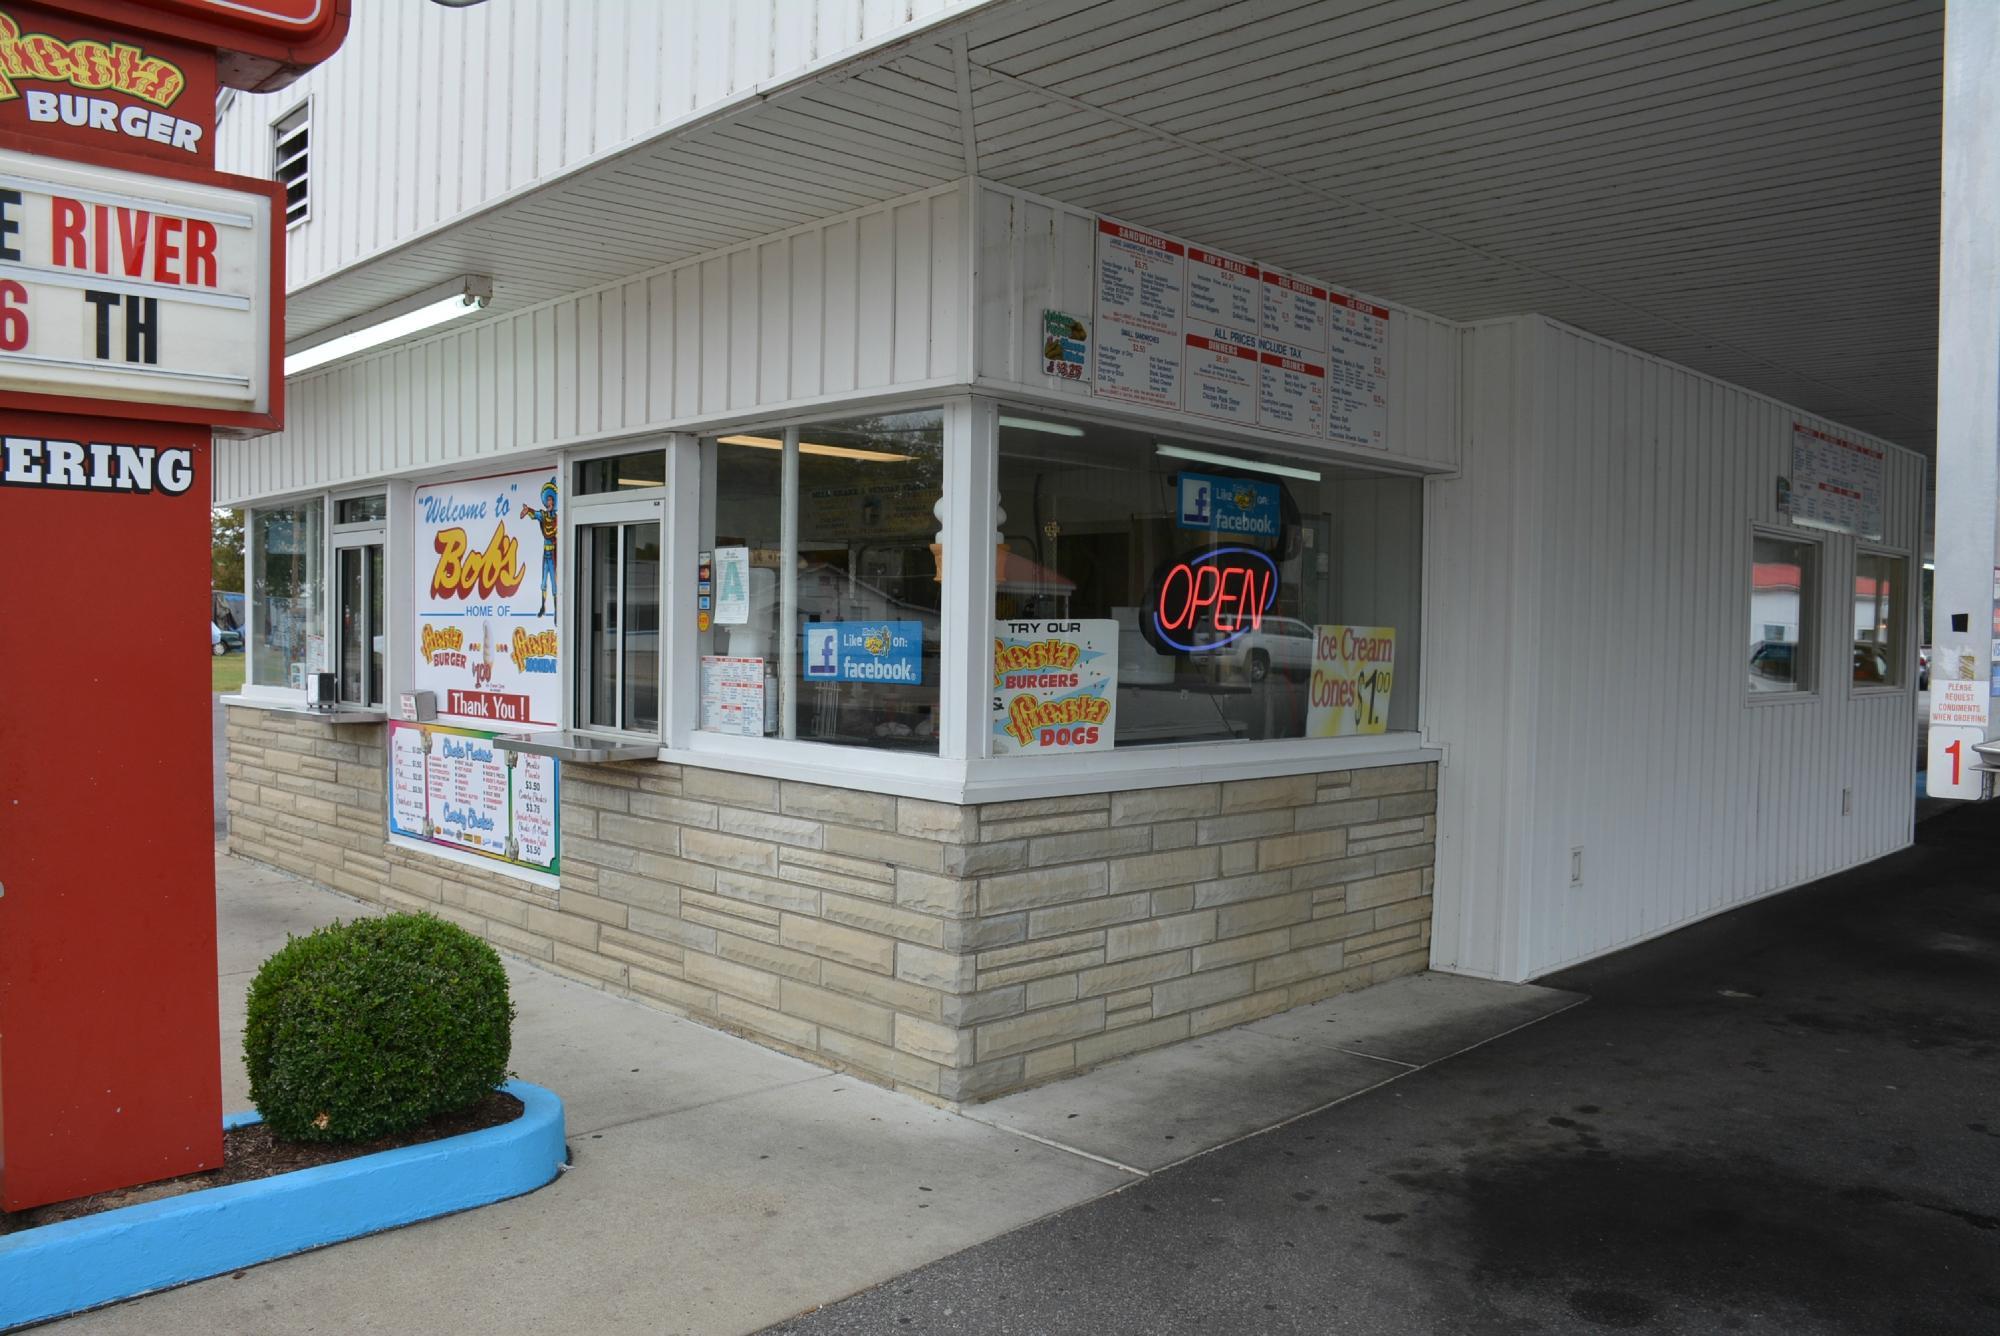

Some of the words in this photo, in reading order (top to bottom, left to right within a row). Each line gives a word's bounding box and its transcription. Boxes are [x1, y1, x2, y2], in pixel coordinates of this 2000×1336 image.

[26, 90, 203, 153] BURGER
[52, 196, 218, 288] RIVER
[1119, 226, 1167, 250] SANDWICHES
[1223, 258, 1247, 275] MEALS
[1356, 301, 1373, 316] CREAM
[85, 290, 158, 364] TH
[1214, 328, 1229, 341] ALL
[1230, 331, 1257, 348] PRICES
[1258, 339, 1288, 356] INCLUDE
[1289, 346, 1304, 360] TAX
[1282, 359, 1305, 373] DRINKS
[4, 436, 193, 493] ERING
[1216, 488, 1233, 501] Like
[431, 519, 526, 600] Bob's
[1159, 563, 1270, 630] OPEN
[466, 605, 493, 617] HOME
[497, 605, 511, 617] OF
[1008, 623, 1040, 633] TRY
[1047, 622, 1081, 633] OUR
[843, 633, 862, 648] Like
[1316, 627, 1337, 661] Ice
[1341, 628, 1393, 663] Cream
[433, 652, 467, 669] BURGER
[1005, 673, 1079, 689] BURGERS
[1311, 670, 1355, 708] Cones
[1948, 682, 1973, 691] PLEASE
[1944, 692, 1975, 702] REQUEST
[452, 693, 489, 717] Thank
[493, 696, 516, 720] You
[1938, 703, 1981, 713] CONDIMENTS
[1932, 713, 1953, 721] WHEN
[1954, 714, 1987, 723] ORDERING
[1040, 727, 1099, 746] DOGS
[1945, 739, 1961, 785] 1
[525, 780, 541, 793] $3.50
[525, 803, 542, 815] $3.75
